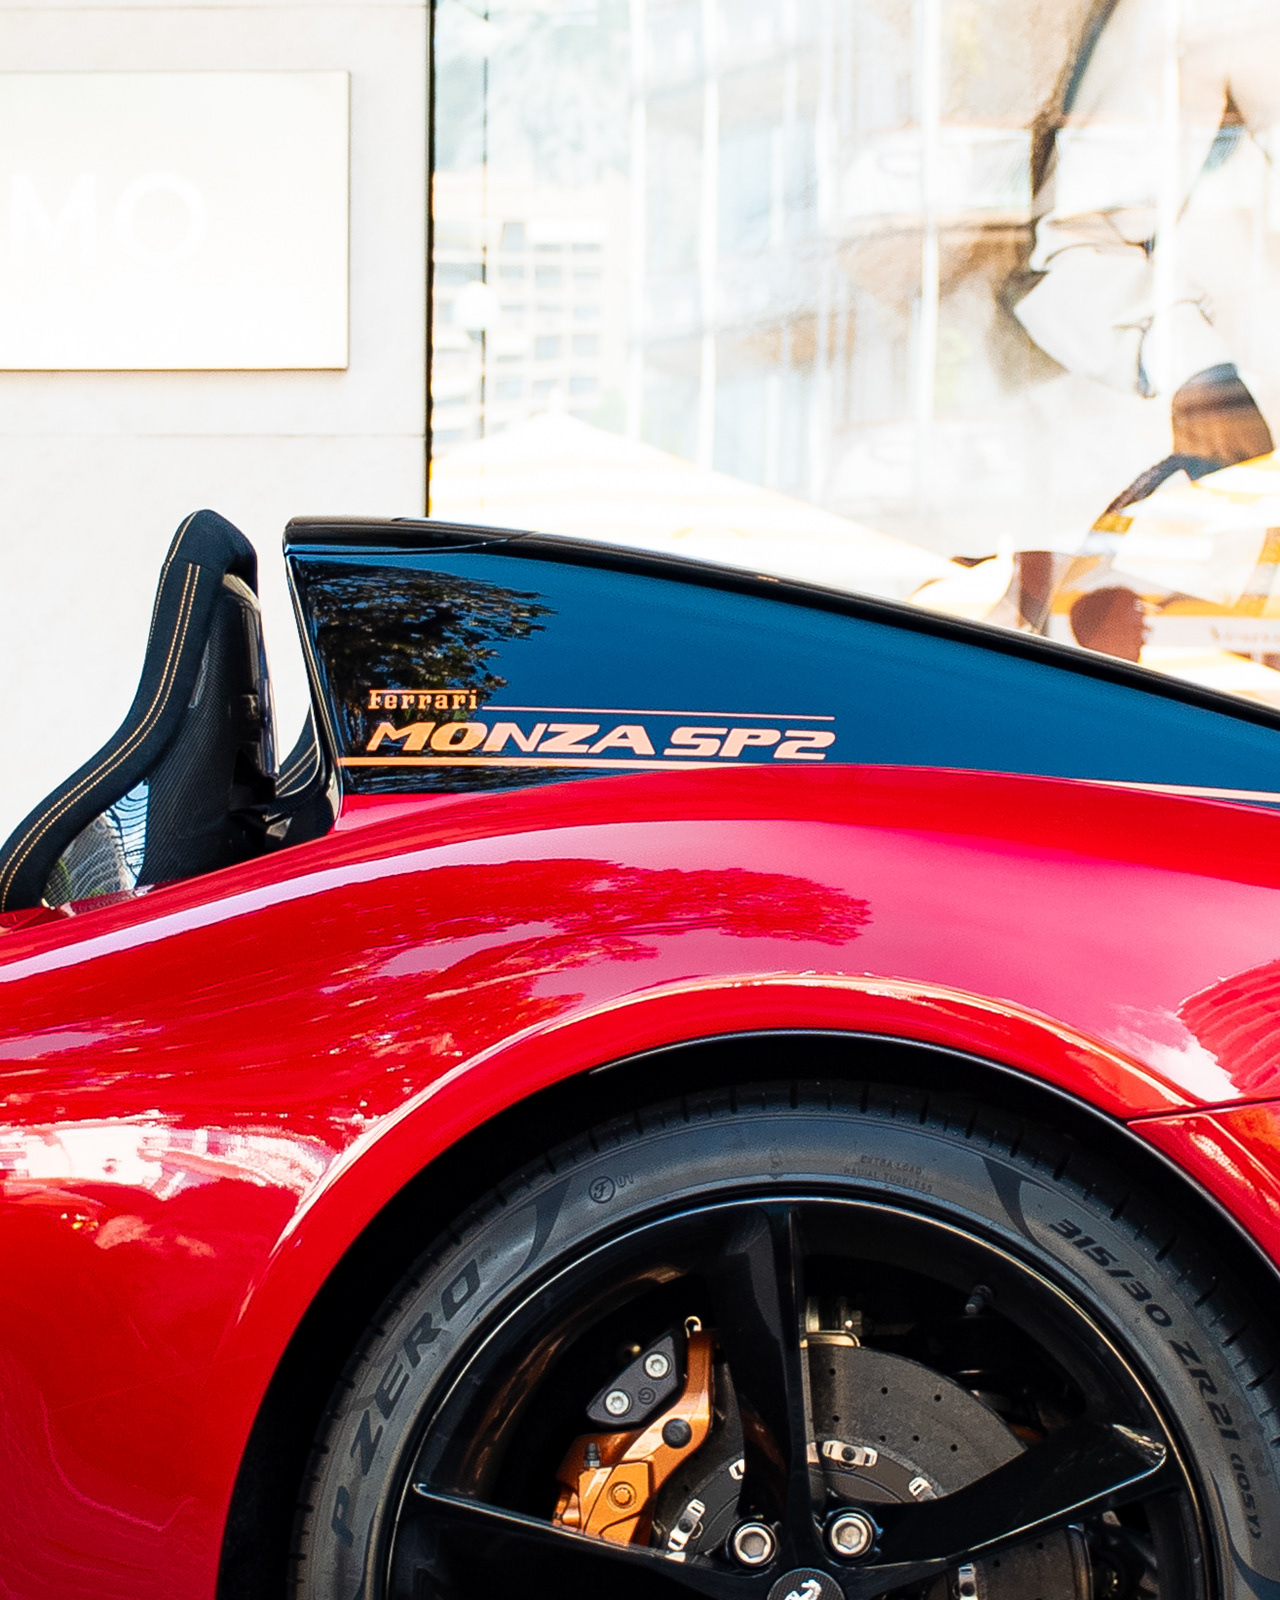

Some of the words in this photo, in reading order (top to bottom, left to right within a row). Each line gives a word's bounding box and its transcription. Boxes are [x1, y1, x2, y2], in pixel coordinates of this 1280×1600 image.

[366, 721, 656, 755] MONZA
[663, 726, 836, 761] SP2
[367, 689, 478, 710] Ferrari
[1049, 1218, 1172, 1328] 315/30
[1169, 1340, 1241, 1440] ZR21
[331, 1485, 354, 1549] P
[349, 1258, 480, 1477] ZERO
